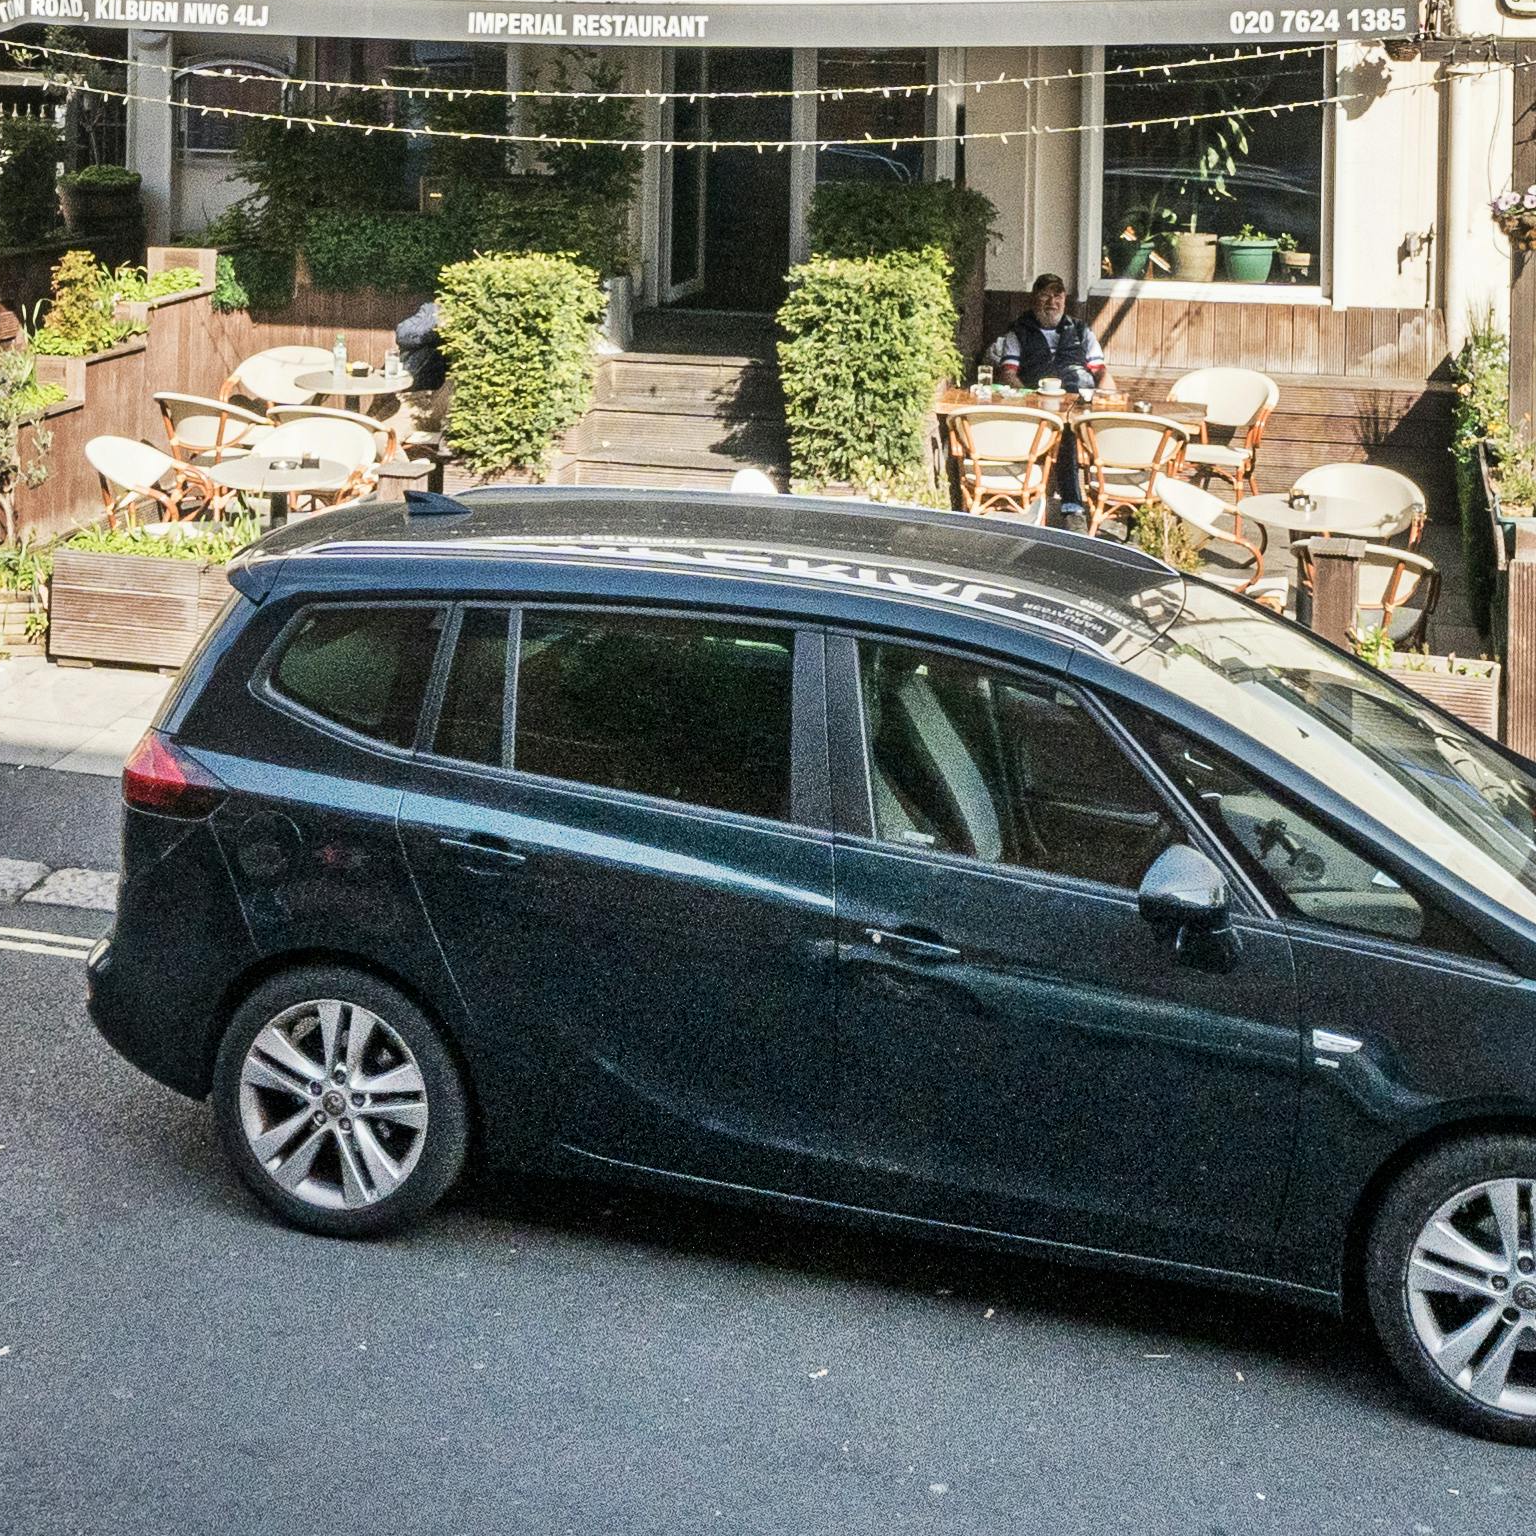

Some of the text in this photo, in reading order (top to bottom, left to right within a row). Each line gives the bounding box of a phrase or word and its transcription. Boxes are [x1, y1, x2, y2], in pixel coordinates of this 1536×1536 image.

[183, 2, 229, 25] NW6
[233, 5, 269, 27] 4LJ
[468, 12, 709, 37] IMPERIAL RESTAURANT
[1229, 7, 1407, 35] 020 7624 1385
